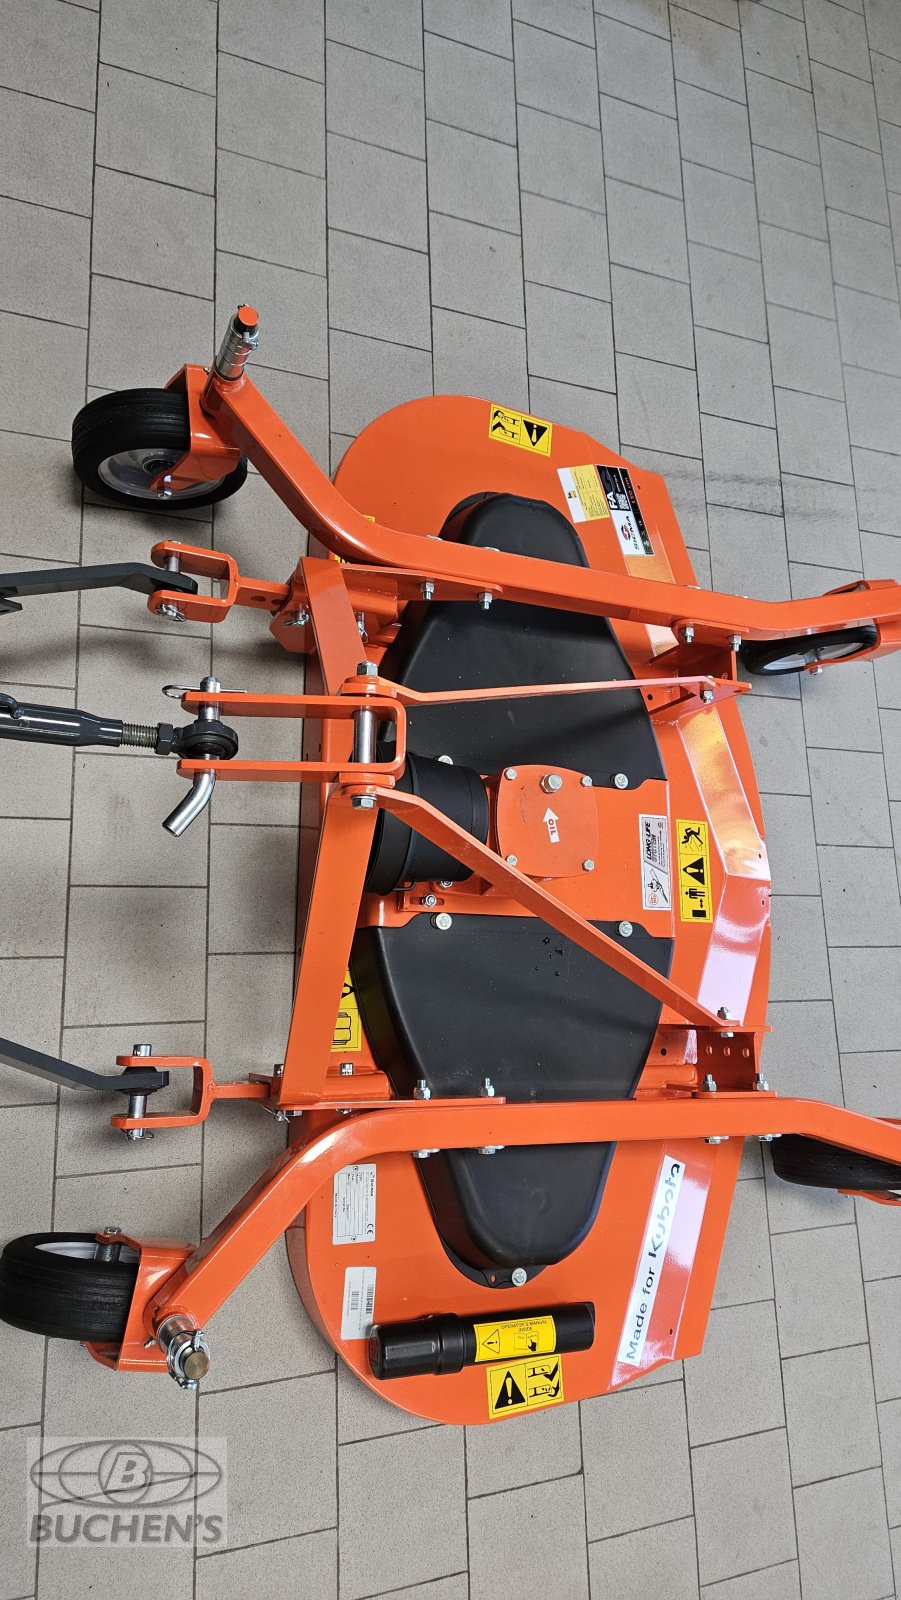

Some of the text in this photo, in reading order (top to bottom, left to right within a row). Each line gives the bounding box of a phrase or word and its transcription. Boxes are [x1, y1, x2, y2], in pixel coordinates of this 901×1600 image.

[607, 491, 618, 509] FA
[625, 515, 639, 551] SIGMA
[547, 819, 556, 836] OIL
[626, 1162, 681, 1360] Made for Kubota
